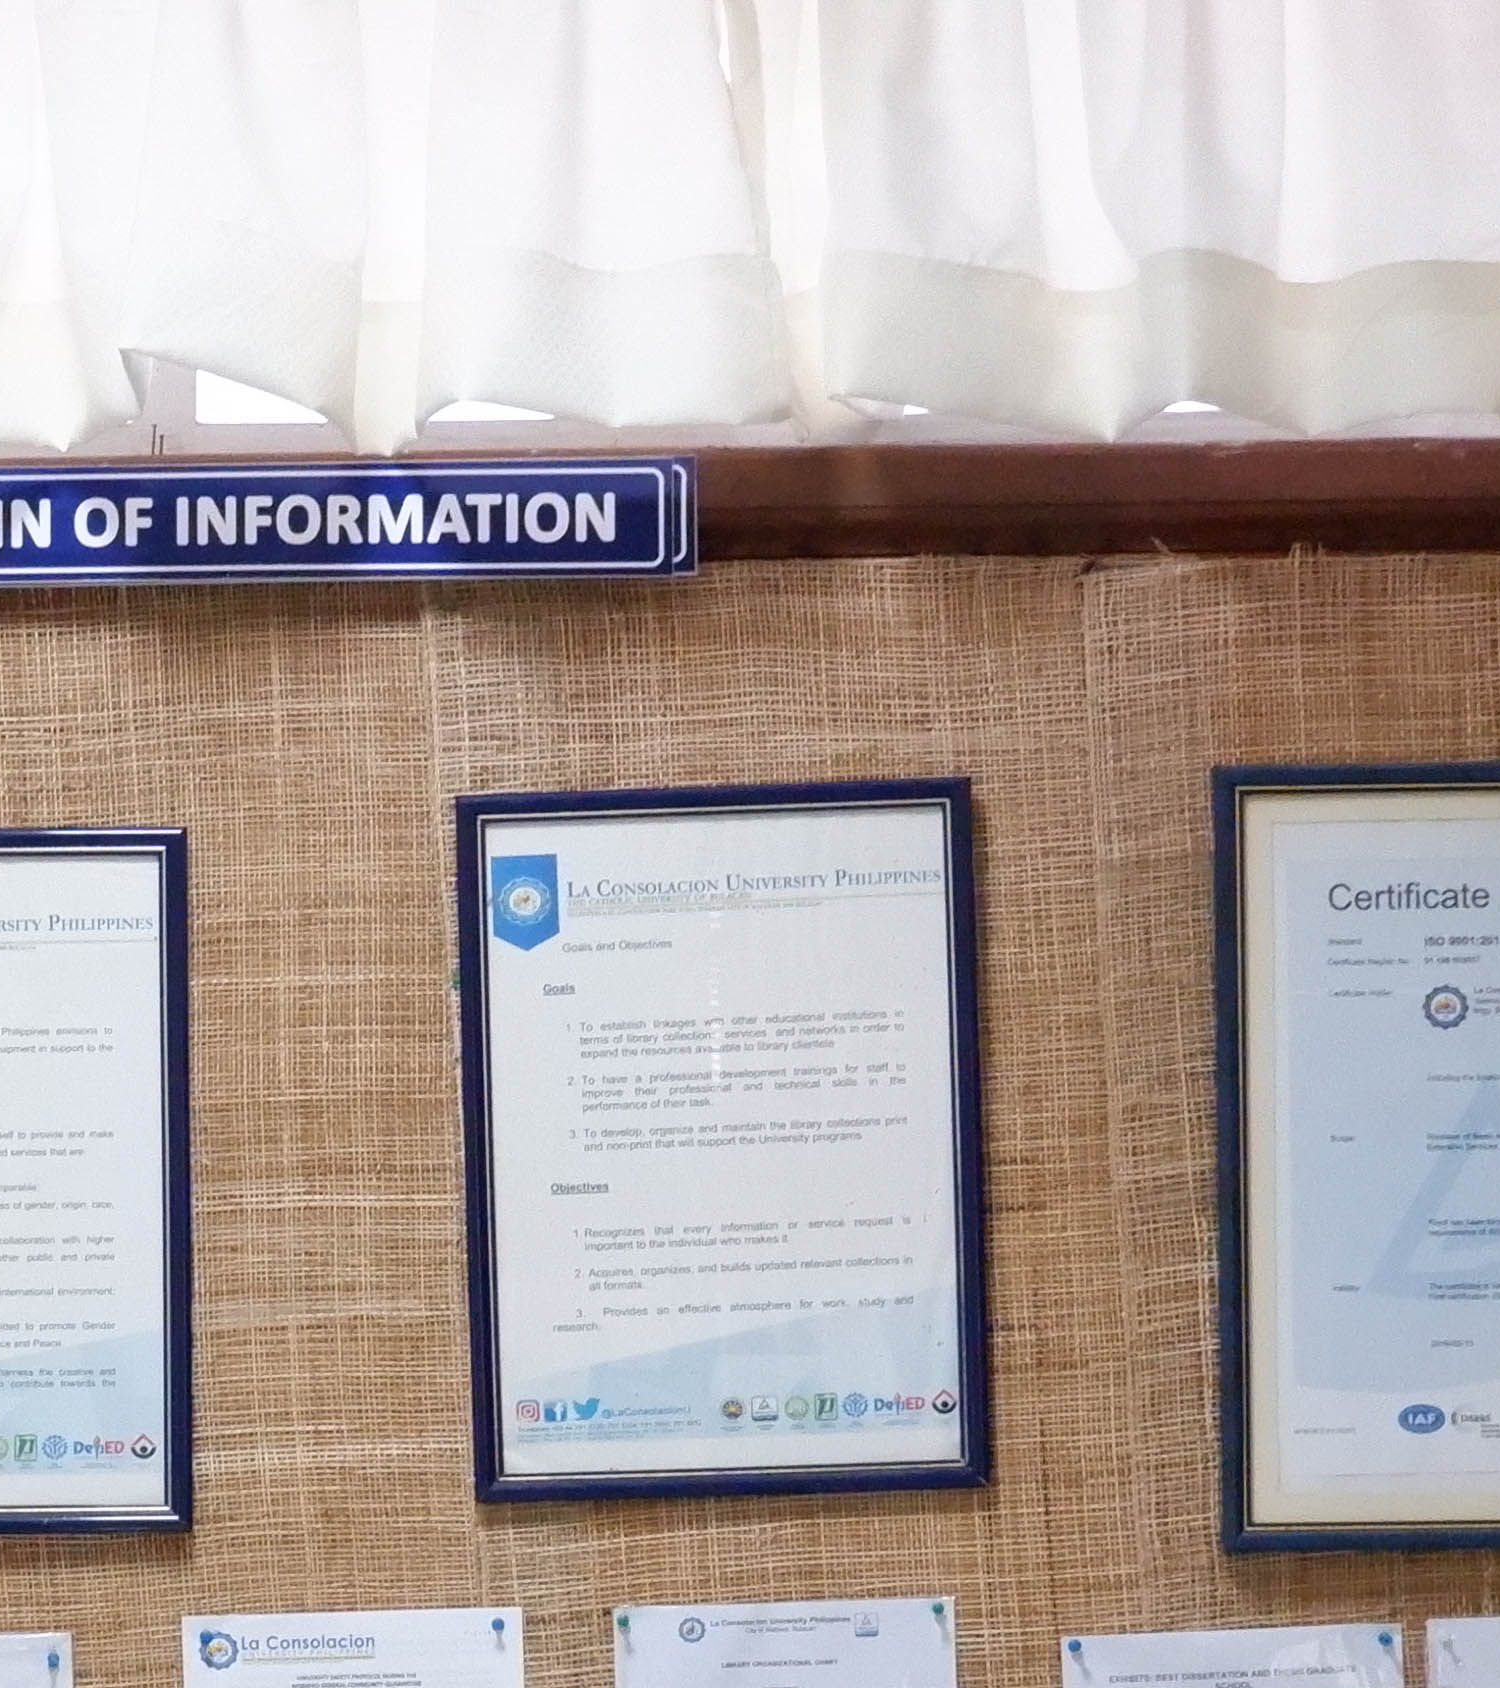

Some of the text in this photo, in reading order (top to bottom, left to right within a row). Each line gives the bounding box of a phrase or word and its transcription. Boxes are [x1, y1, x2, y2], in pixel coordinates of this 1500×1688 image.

[72, 496, 154, 549] OF
[174, 491, 618, 548] INFORMATION
[1328, 882, 1490, 911] Certificate
[596, 941, 616, 952] and
[1424, 937, 1444, 948] ISO
[542, 983, 576, 996] Goals
[550, 1182, 609, 1195] Objectives
[1408, 1413, 1437, 1425] IAF
[241, 1634, 376, 1651] La Consolacion
